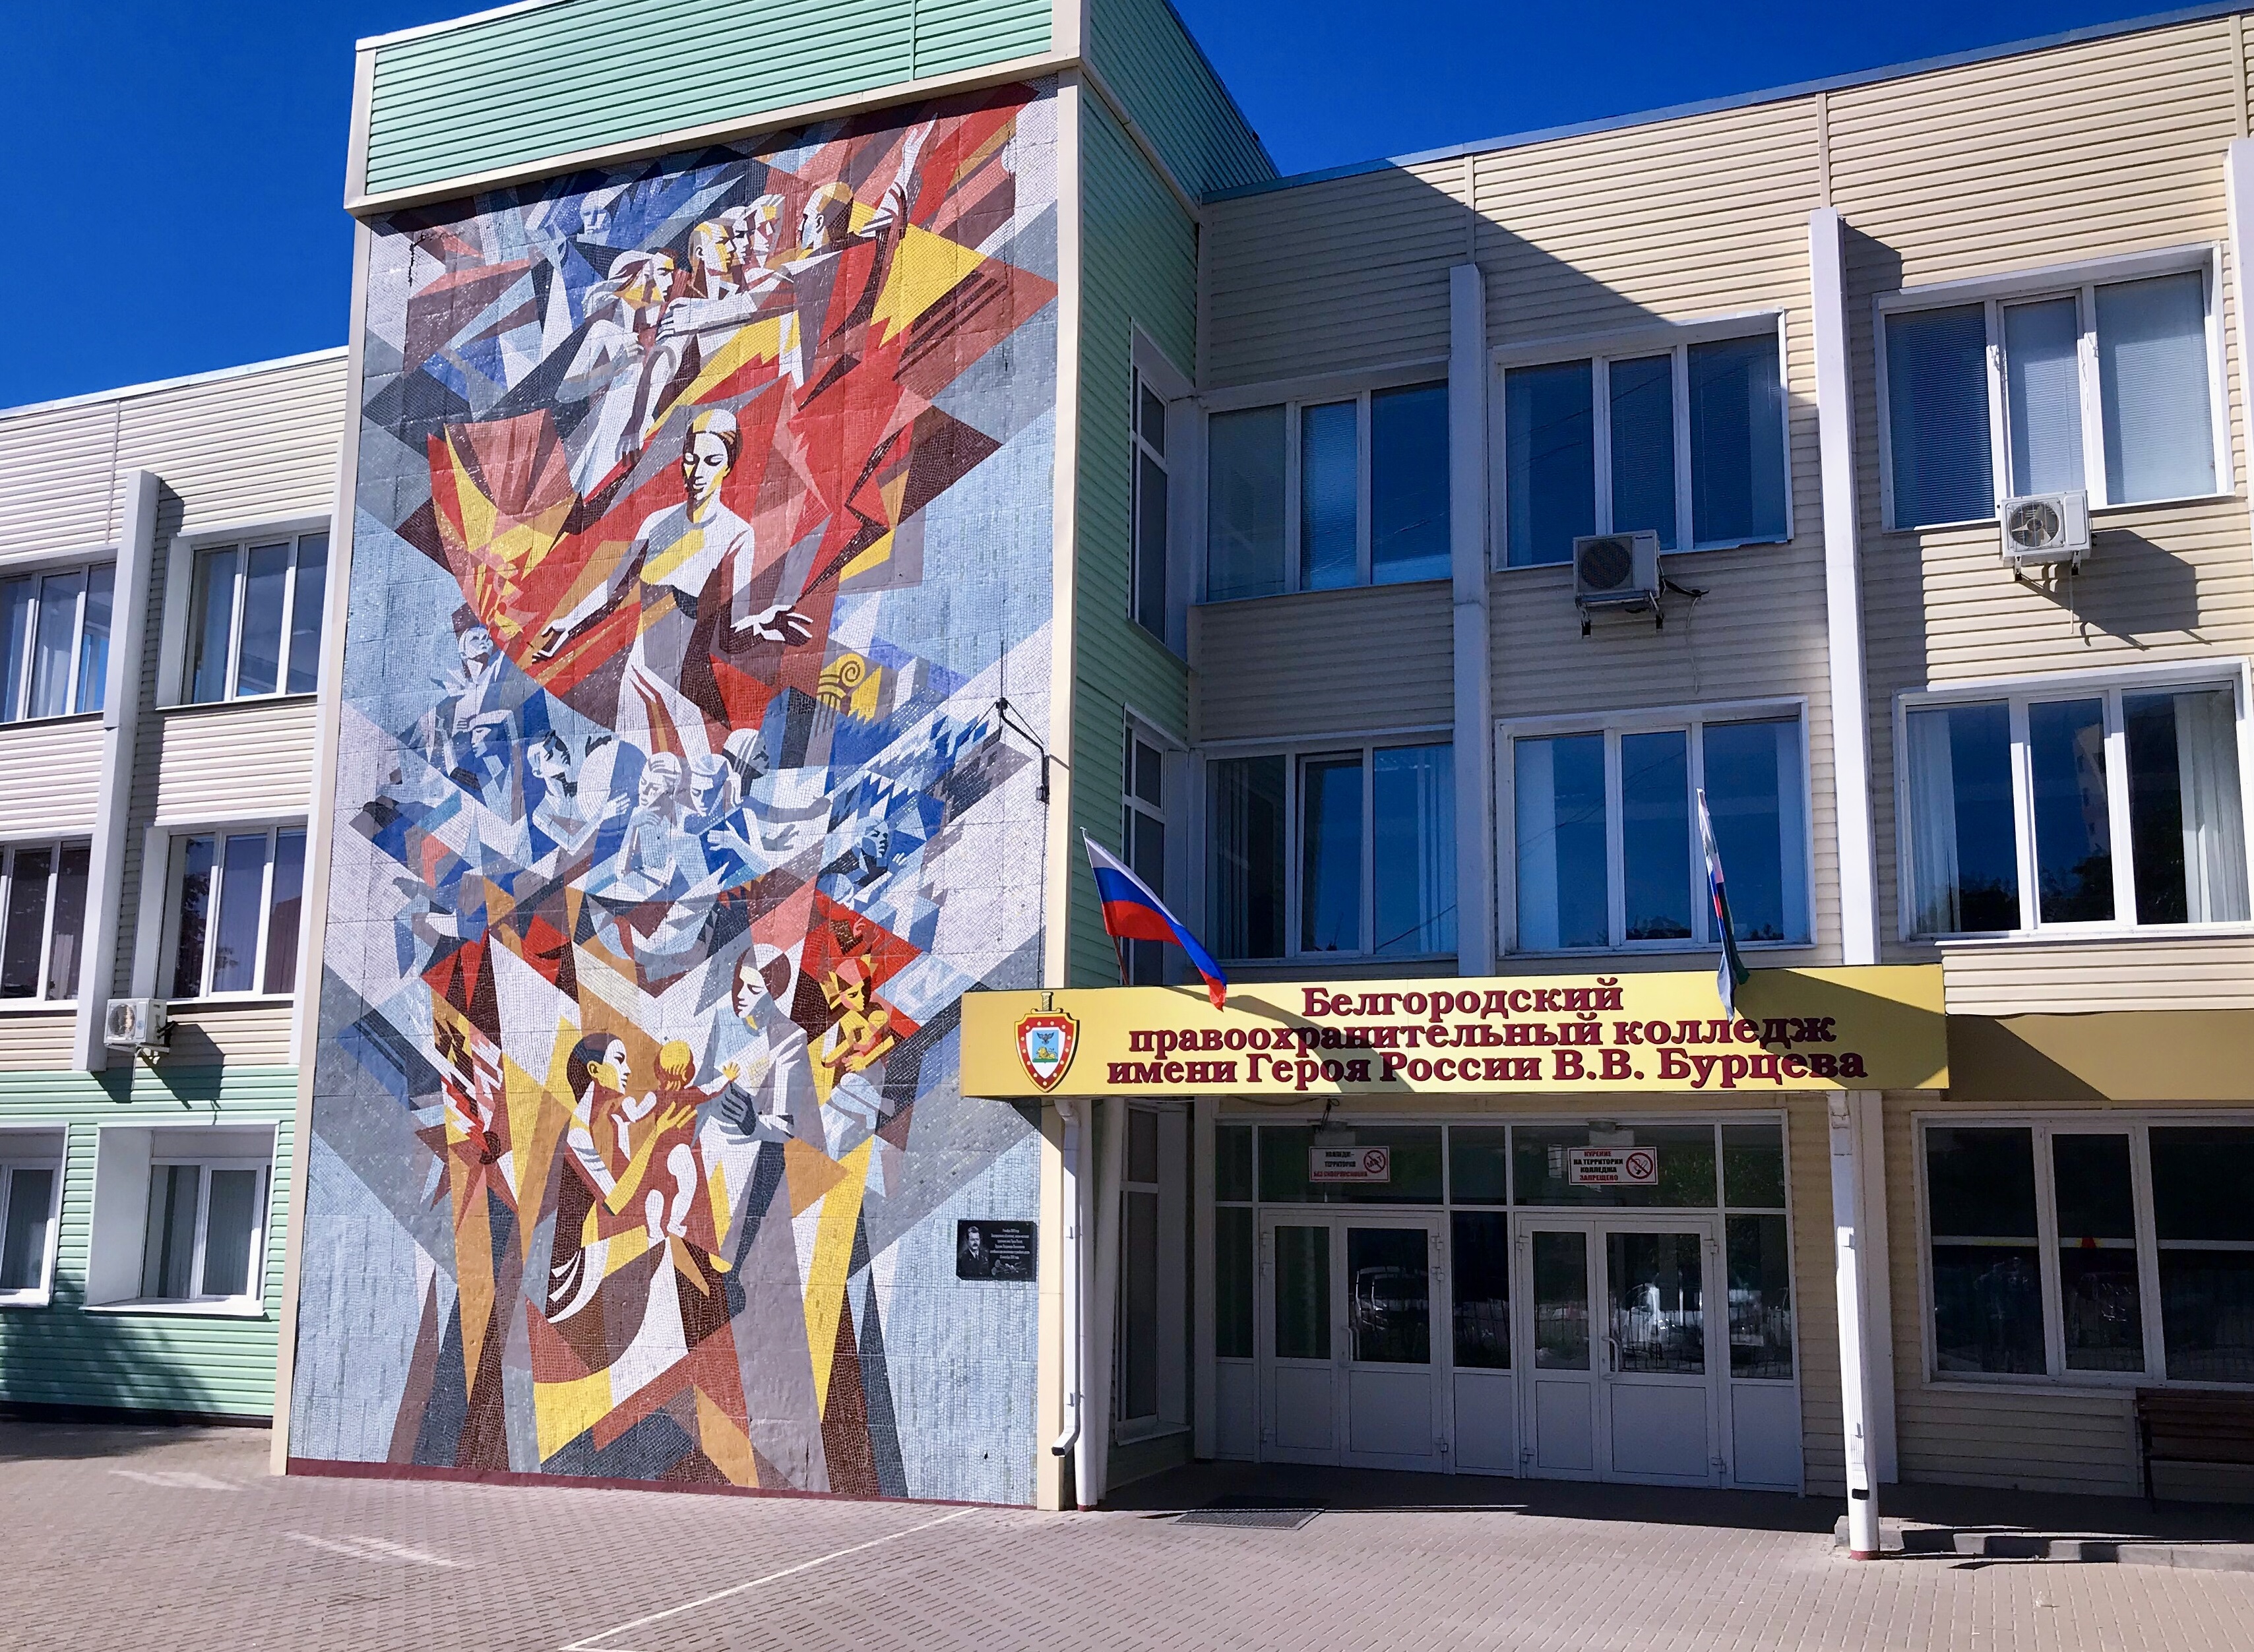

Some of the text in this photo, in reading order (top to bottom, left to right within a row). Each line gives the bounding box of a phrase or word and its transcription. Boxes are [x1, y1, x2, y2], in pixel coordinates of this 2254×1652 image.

[1301, 977, 1623, 1023] Белгородский
[1129, 1012, 1837, 1060] правоохранительный колледж
[1108, 1047, 1868, 1090] имени Героя России В.В. Бурцева
